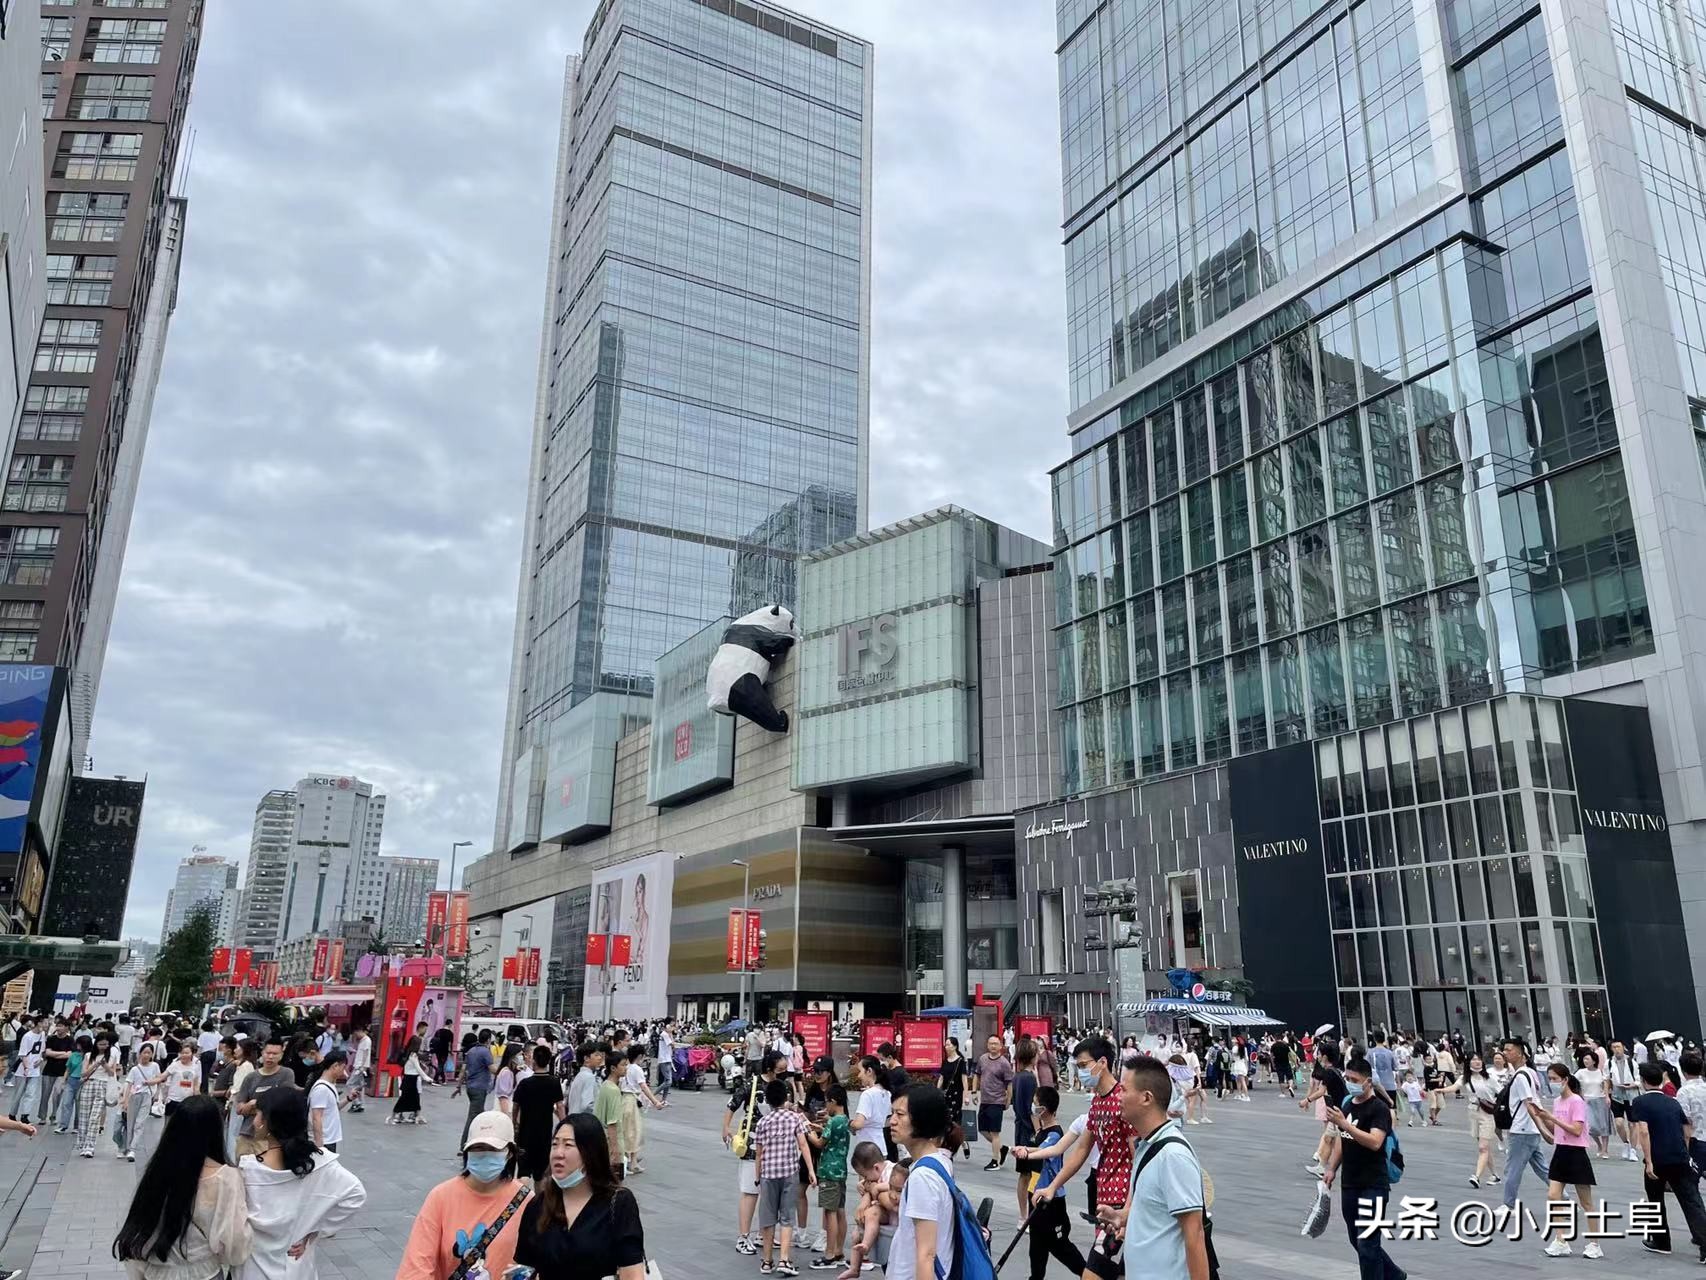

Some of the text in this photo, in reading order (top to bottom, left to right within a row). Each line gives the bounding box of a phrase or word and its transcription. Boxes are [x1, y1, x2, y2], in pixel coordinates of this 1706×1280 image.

[838, 613, 897, 676] IFS
[313, 777, 336, 787] ICBC
[94, 805, 135, 827] UR
[1584, 808, 1666, 832] VALENTINO
[1025, 818, 1090, 840] Salvatore Ferragamo
[1243, 837, 1308, 860] VALENTINO
[753, 883, 783, 900] PRADA
[623, 964, 644, 983] FENDI
